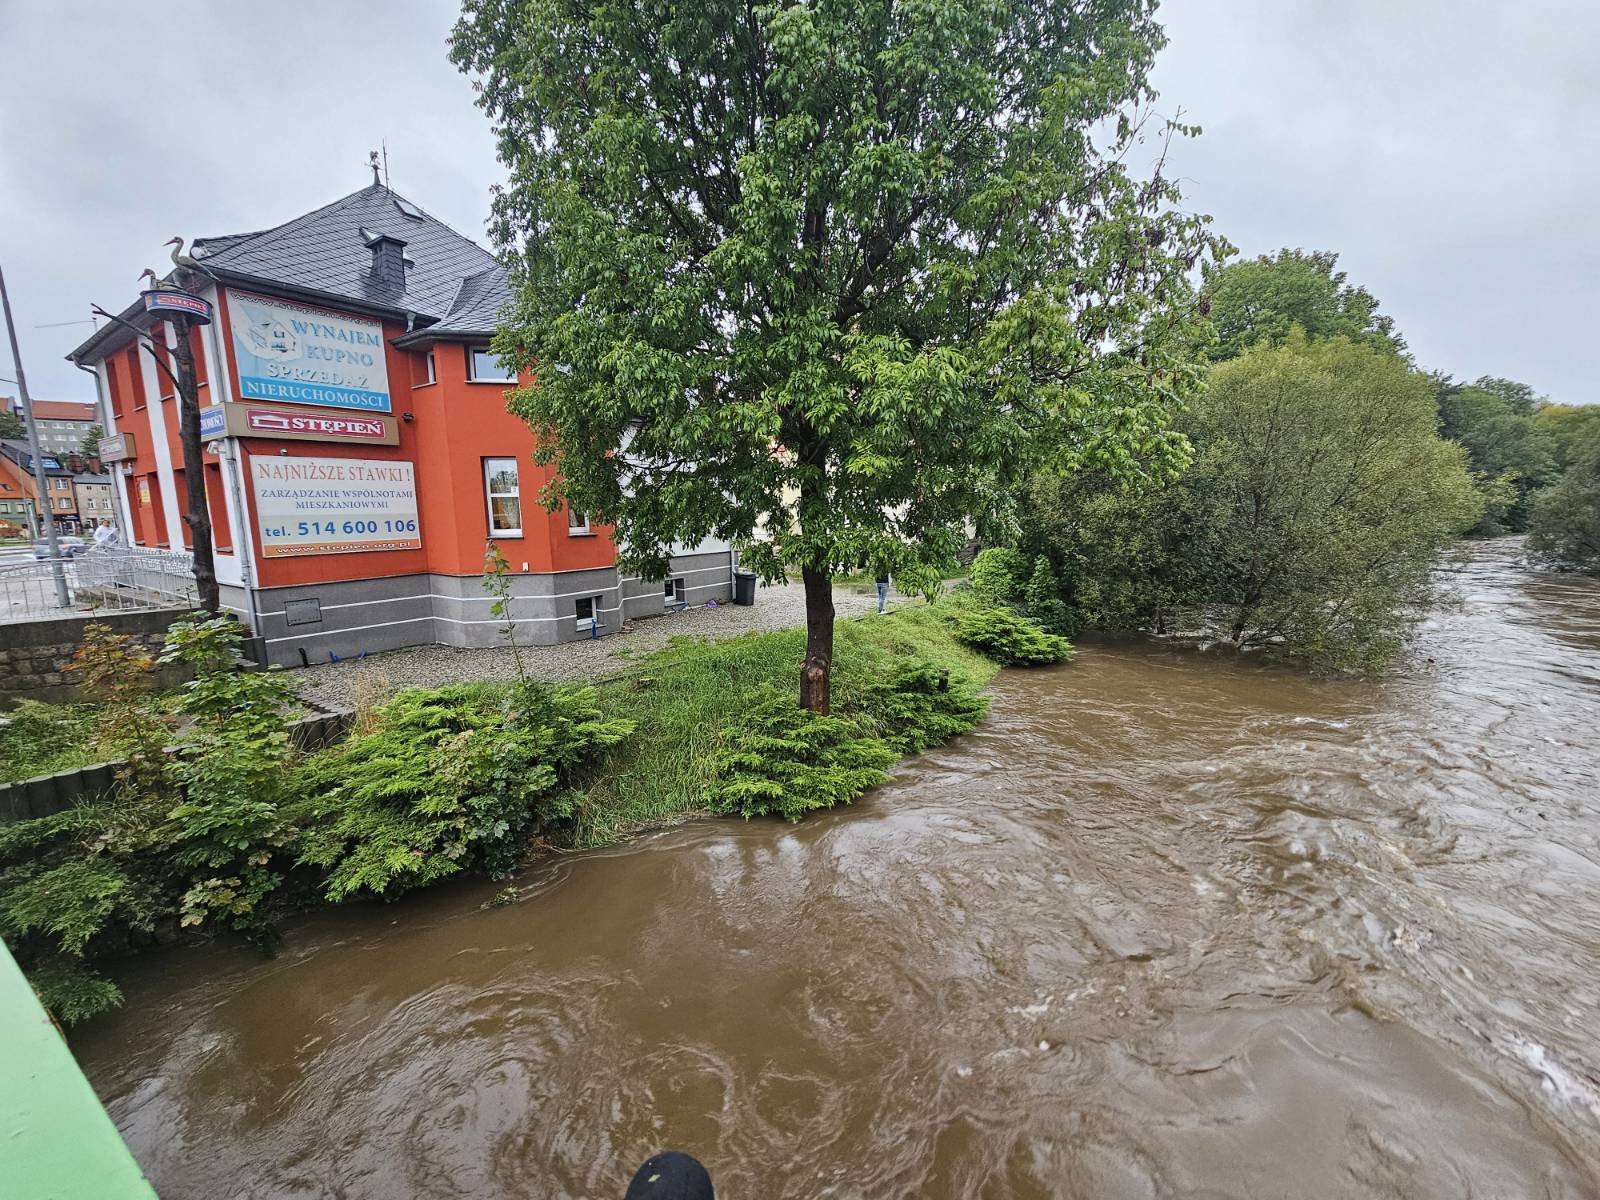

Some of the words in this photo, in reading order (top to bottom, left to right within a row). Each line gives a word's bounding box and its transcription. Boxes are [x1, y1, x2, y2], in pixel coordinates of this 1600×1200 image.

[291, 319, 379, 347] WYNAJEM
[307, 345, 373, 367] KUPNO
[246, 381, 383, 407] NIERUCHOMOŚCI
[292, 417, 382, 435] STĘPIEŃ
[258, 462, 345, 482] NAJNIŻSZE
[349, 467, 403, 482] STAWKI
[261, 489, 340, 500] ZARZĄDZANIE
[295, 501, 389, 510] MIESZKANIOWYMI
[265, 525, 291, 537] tel.
[298, 521, 336, 536] 514
[342, 520, 378, 534] 600
[384, 519, 416, 533] 106
[276, 541, 411, 554] www.stepien.org.pl
